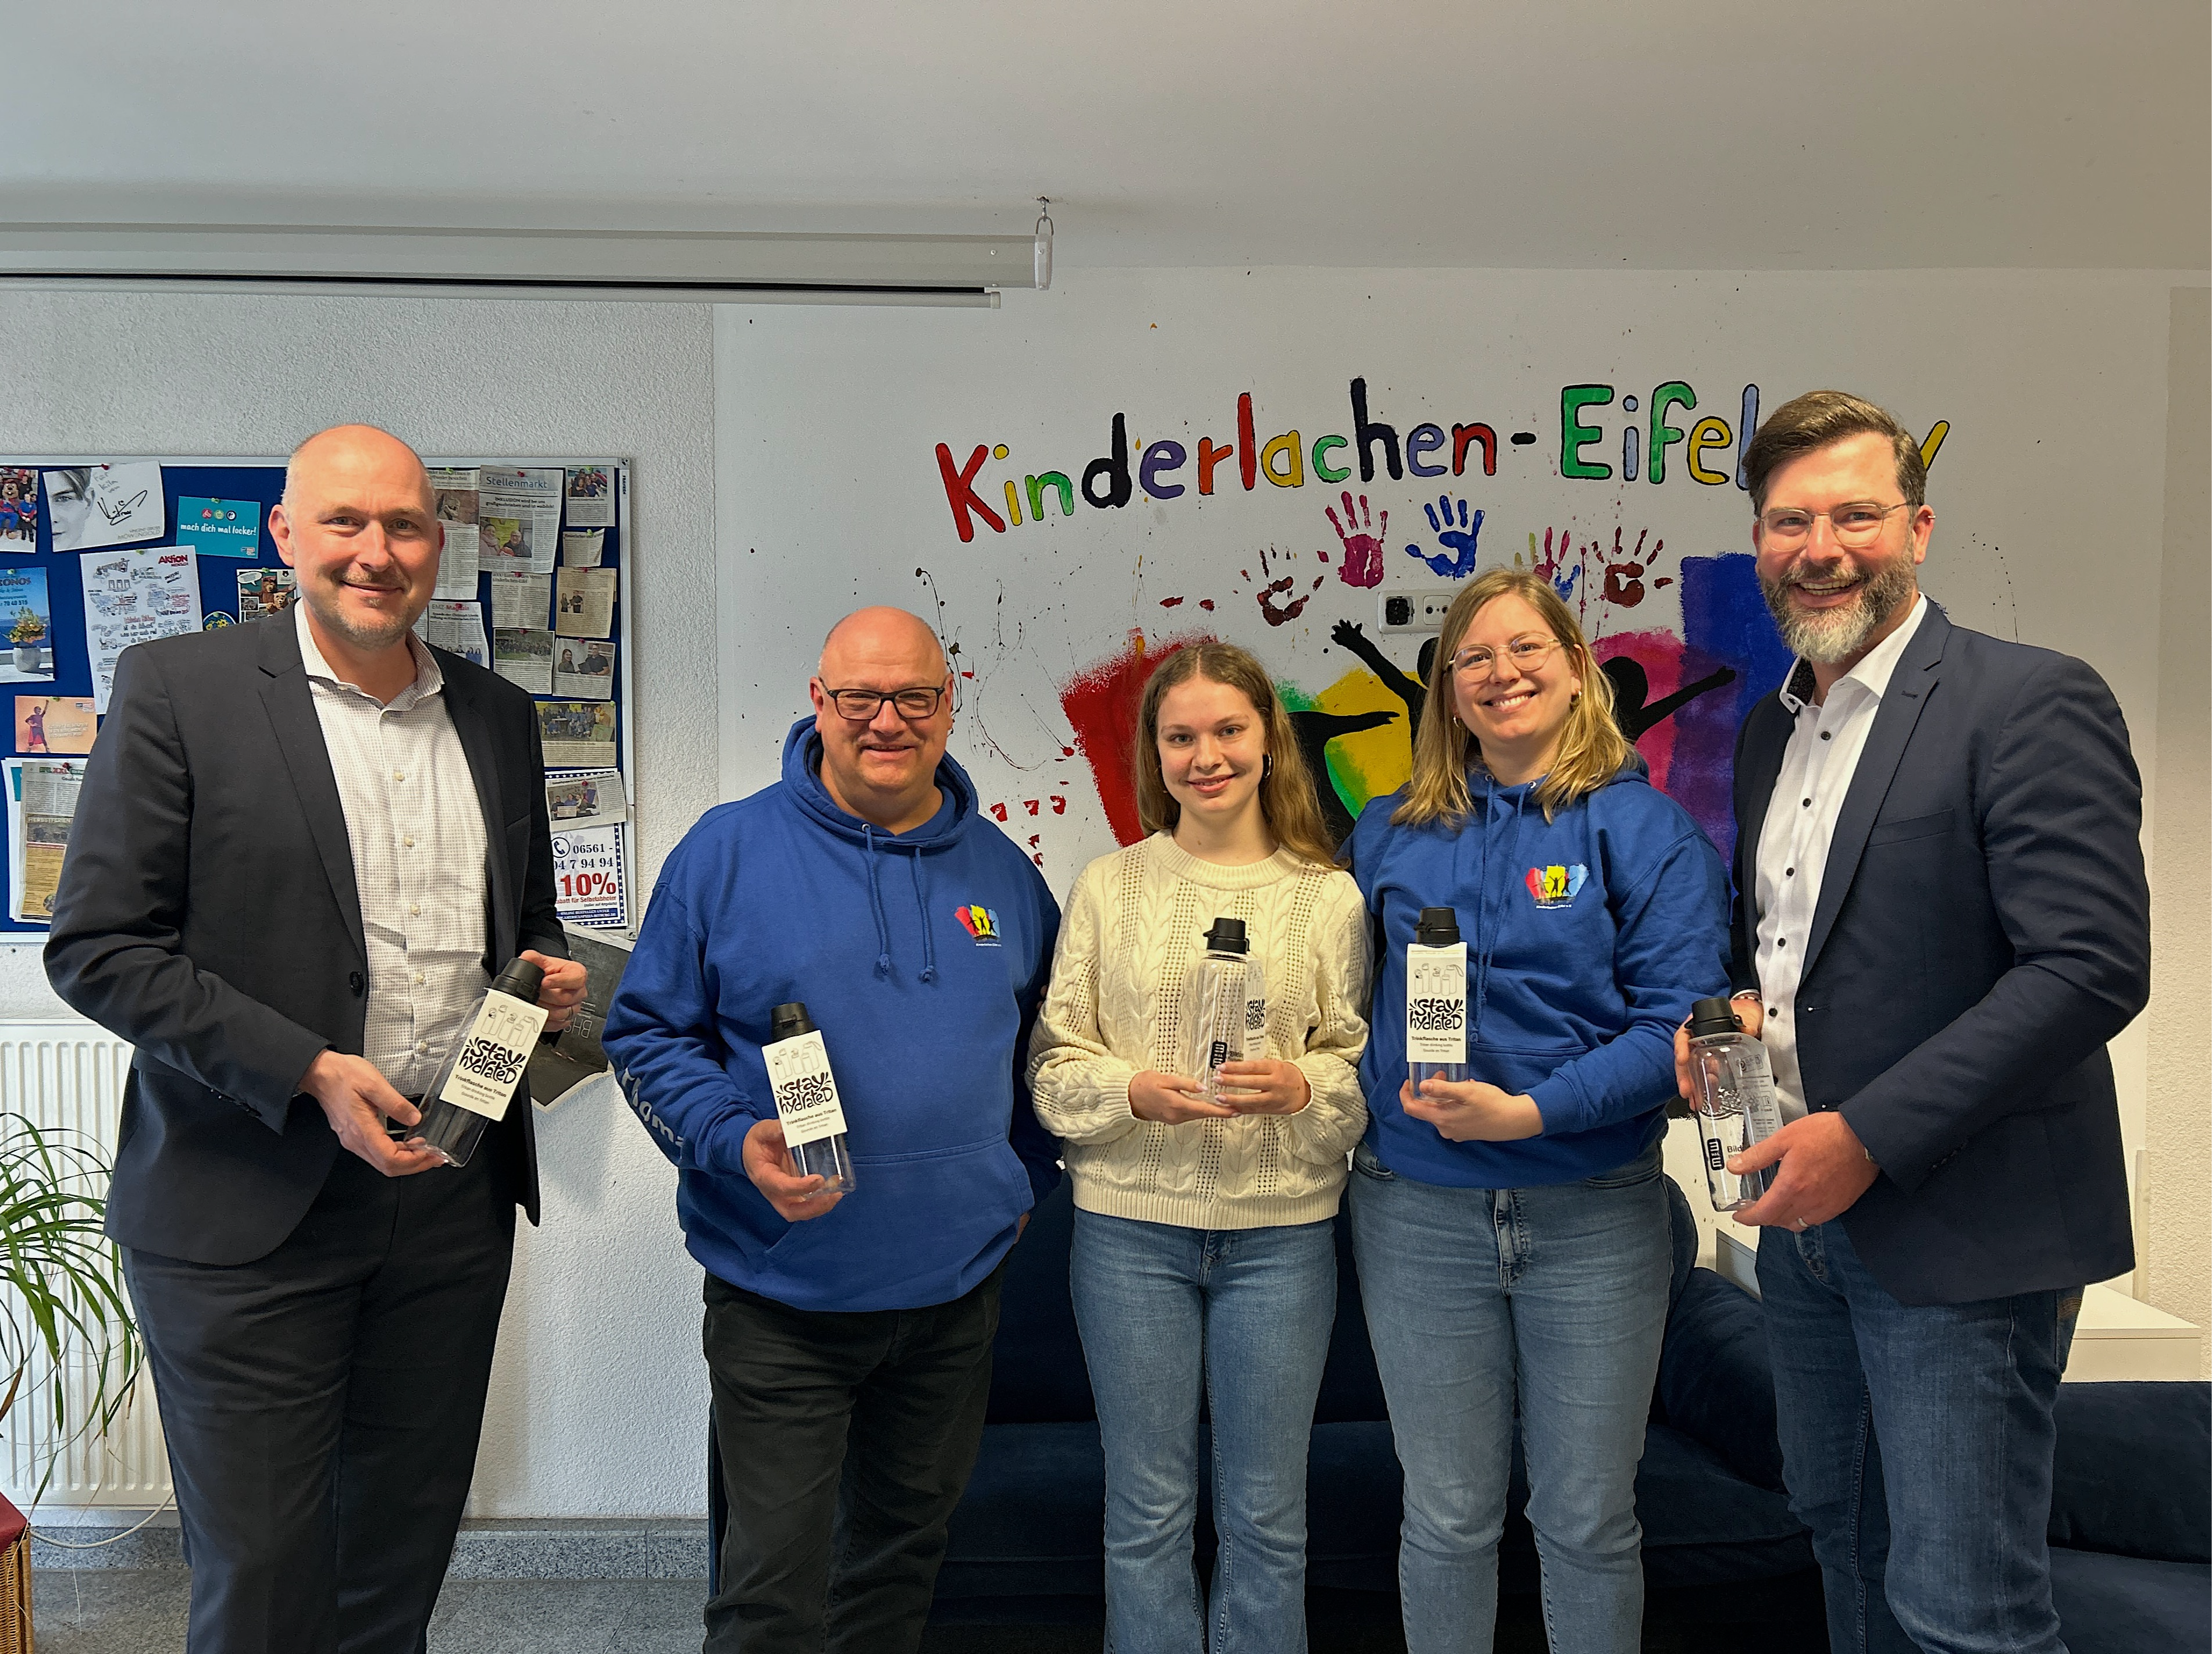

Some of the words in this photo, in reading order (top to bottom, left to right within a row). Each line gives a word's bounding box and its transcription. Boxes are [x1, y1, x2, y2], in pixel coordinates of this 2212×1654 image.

[486, 476, 548, 489] Stellenmarkt
[180, 523, 199, 531] mach
[201, 523, 216, 532] dich
[218, 525, 231, 533] mal
[232, 526, 257, 535] locker!
[573, 843, 605, 854] 06561
[570, 860, 576, 869] 7
[581, 858, 596, 868] 94
[600, 857, 614, 867] 94
[560, 872, 616, 896] 10%
[1727, 1145, 1743, 1153] Bild
